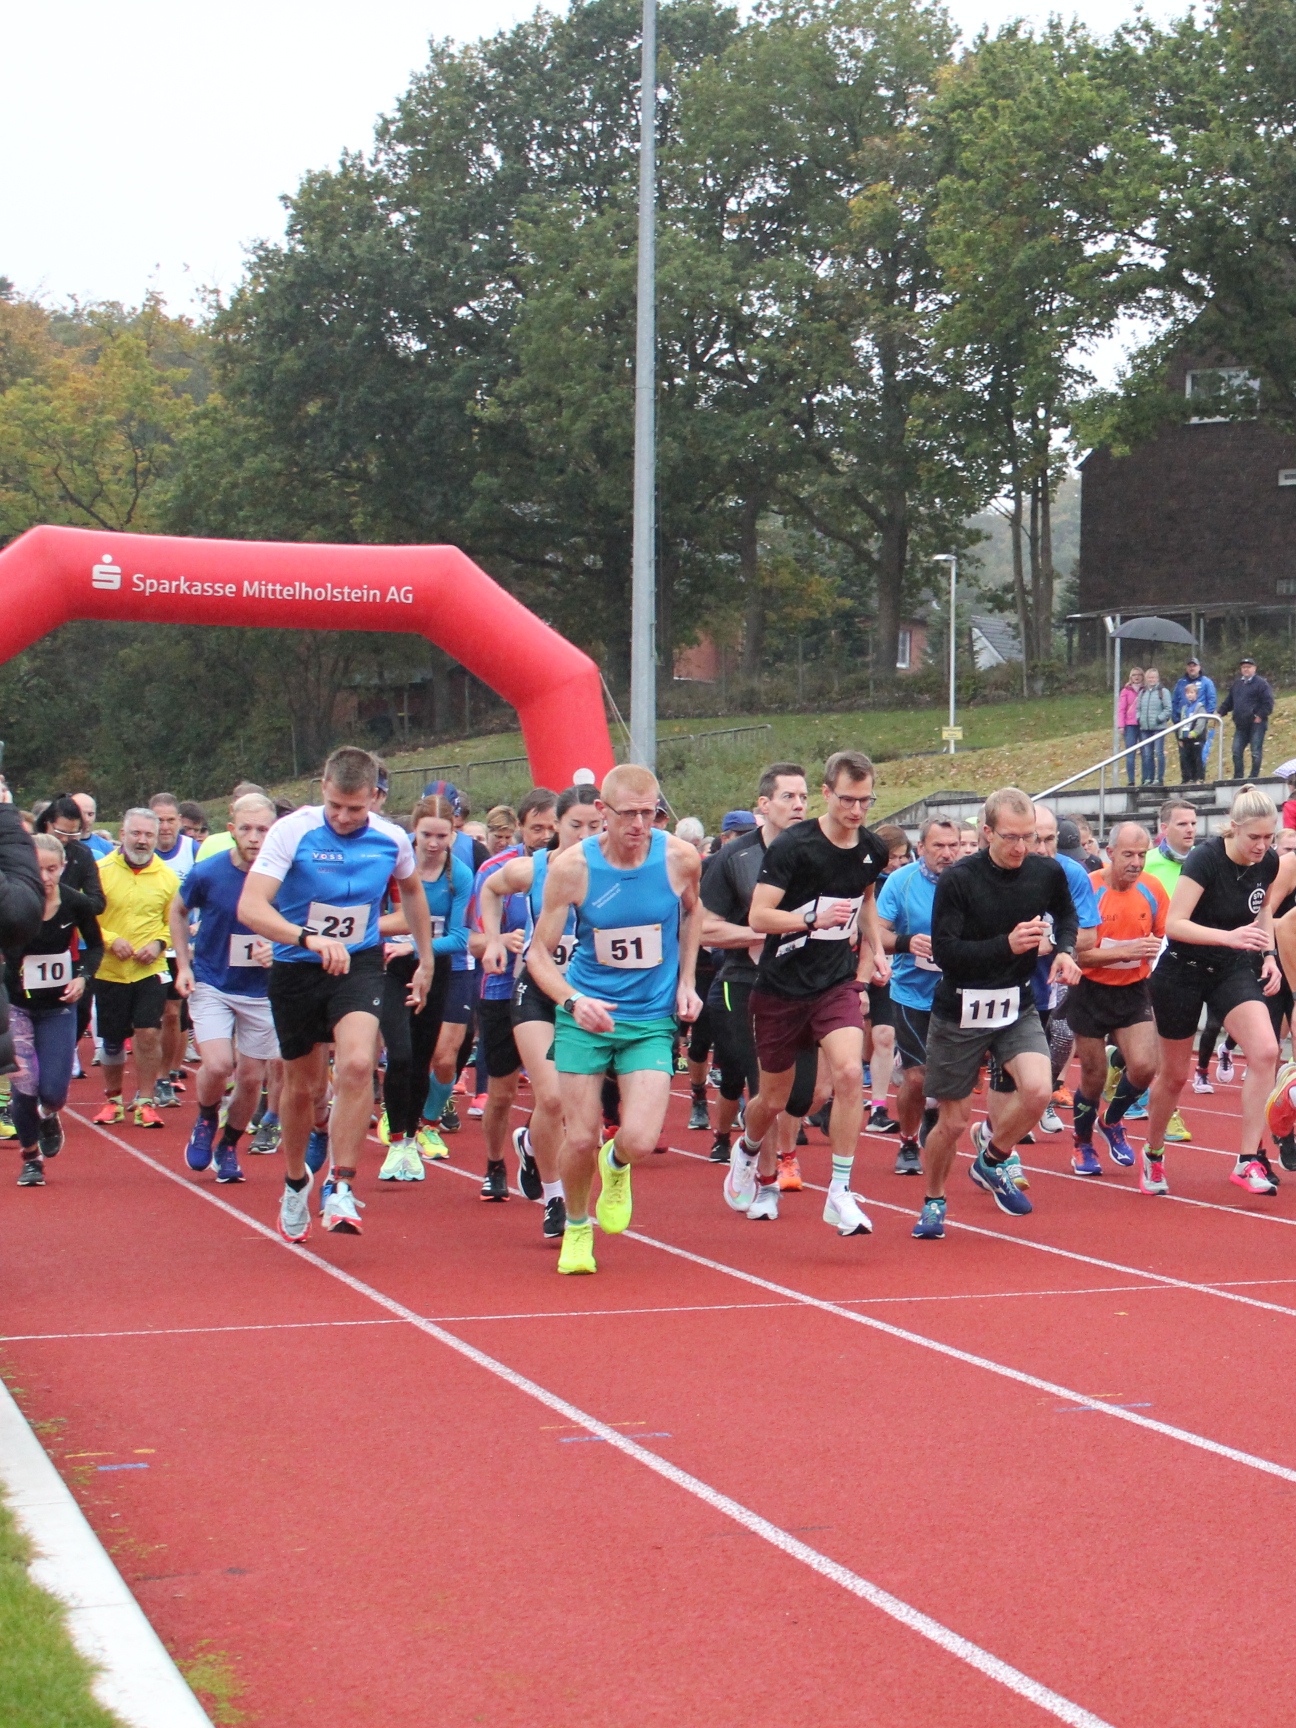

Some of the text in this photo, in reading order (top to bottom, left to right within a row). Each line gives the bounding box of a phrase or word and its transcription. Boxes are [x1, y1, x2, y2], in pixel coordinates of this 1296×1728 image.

[132, 574, 413, 604] Sparkasse Mittelholstein AG
[312, 852, 343, 860] VOSS
[321, 916, 355, 938] 23
[611, 937, 643, 960] 51
[37, 962, 64, 981] 10
[970, 998, 1010, 1020] 111
